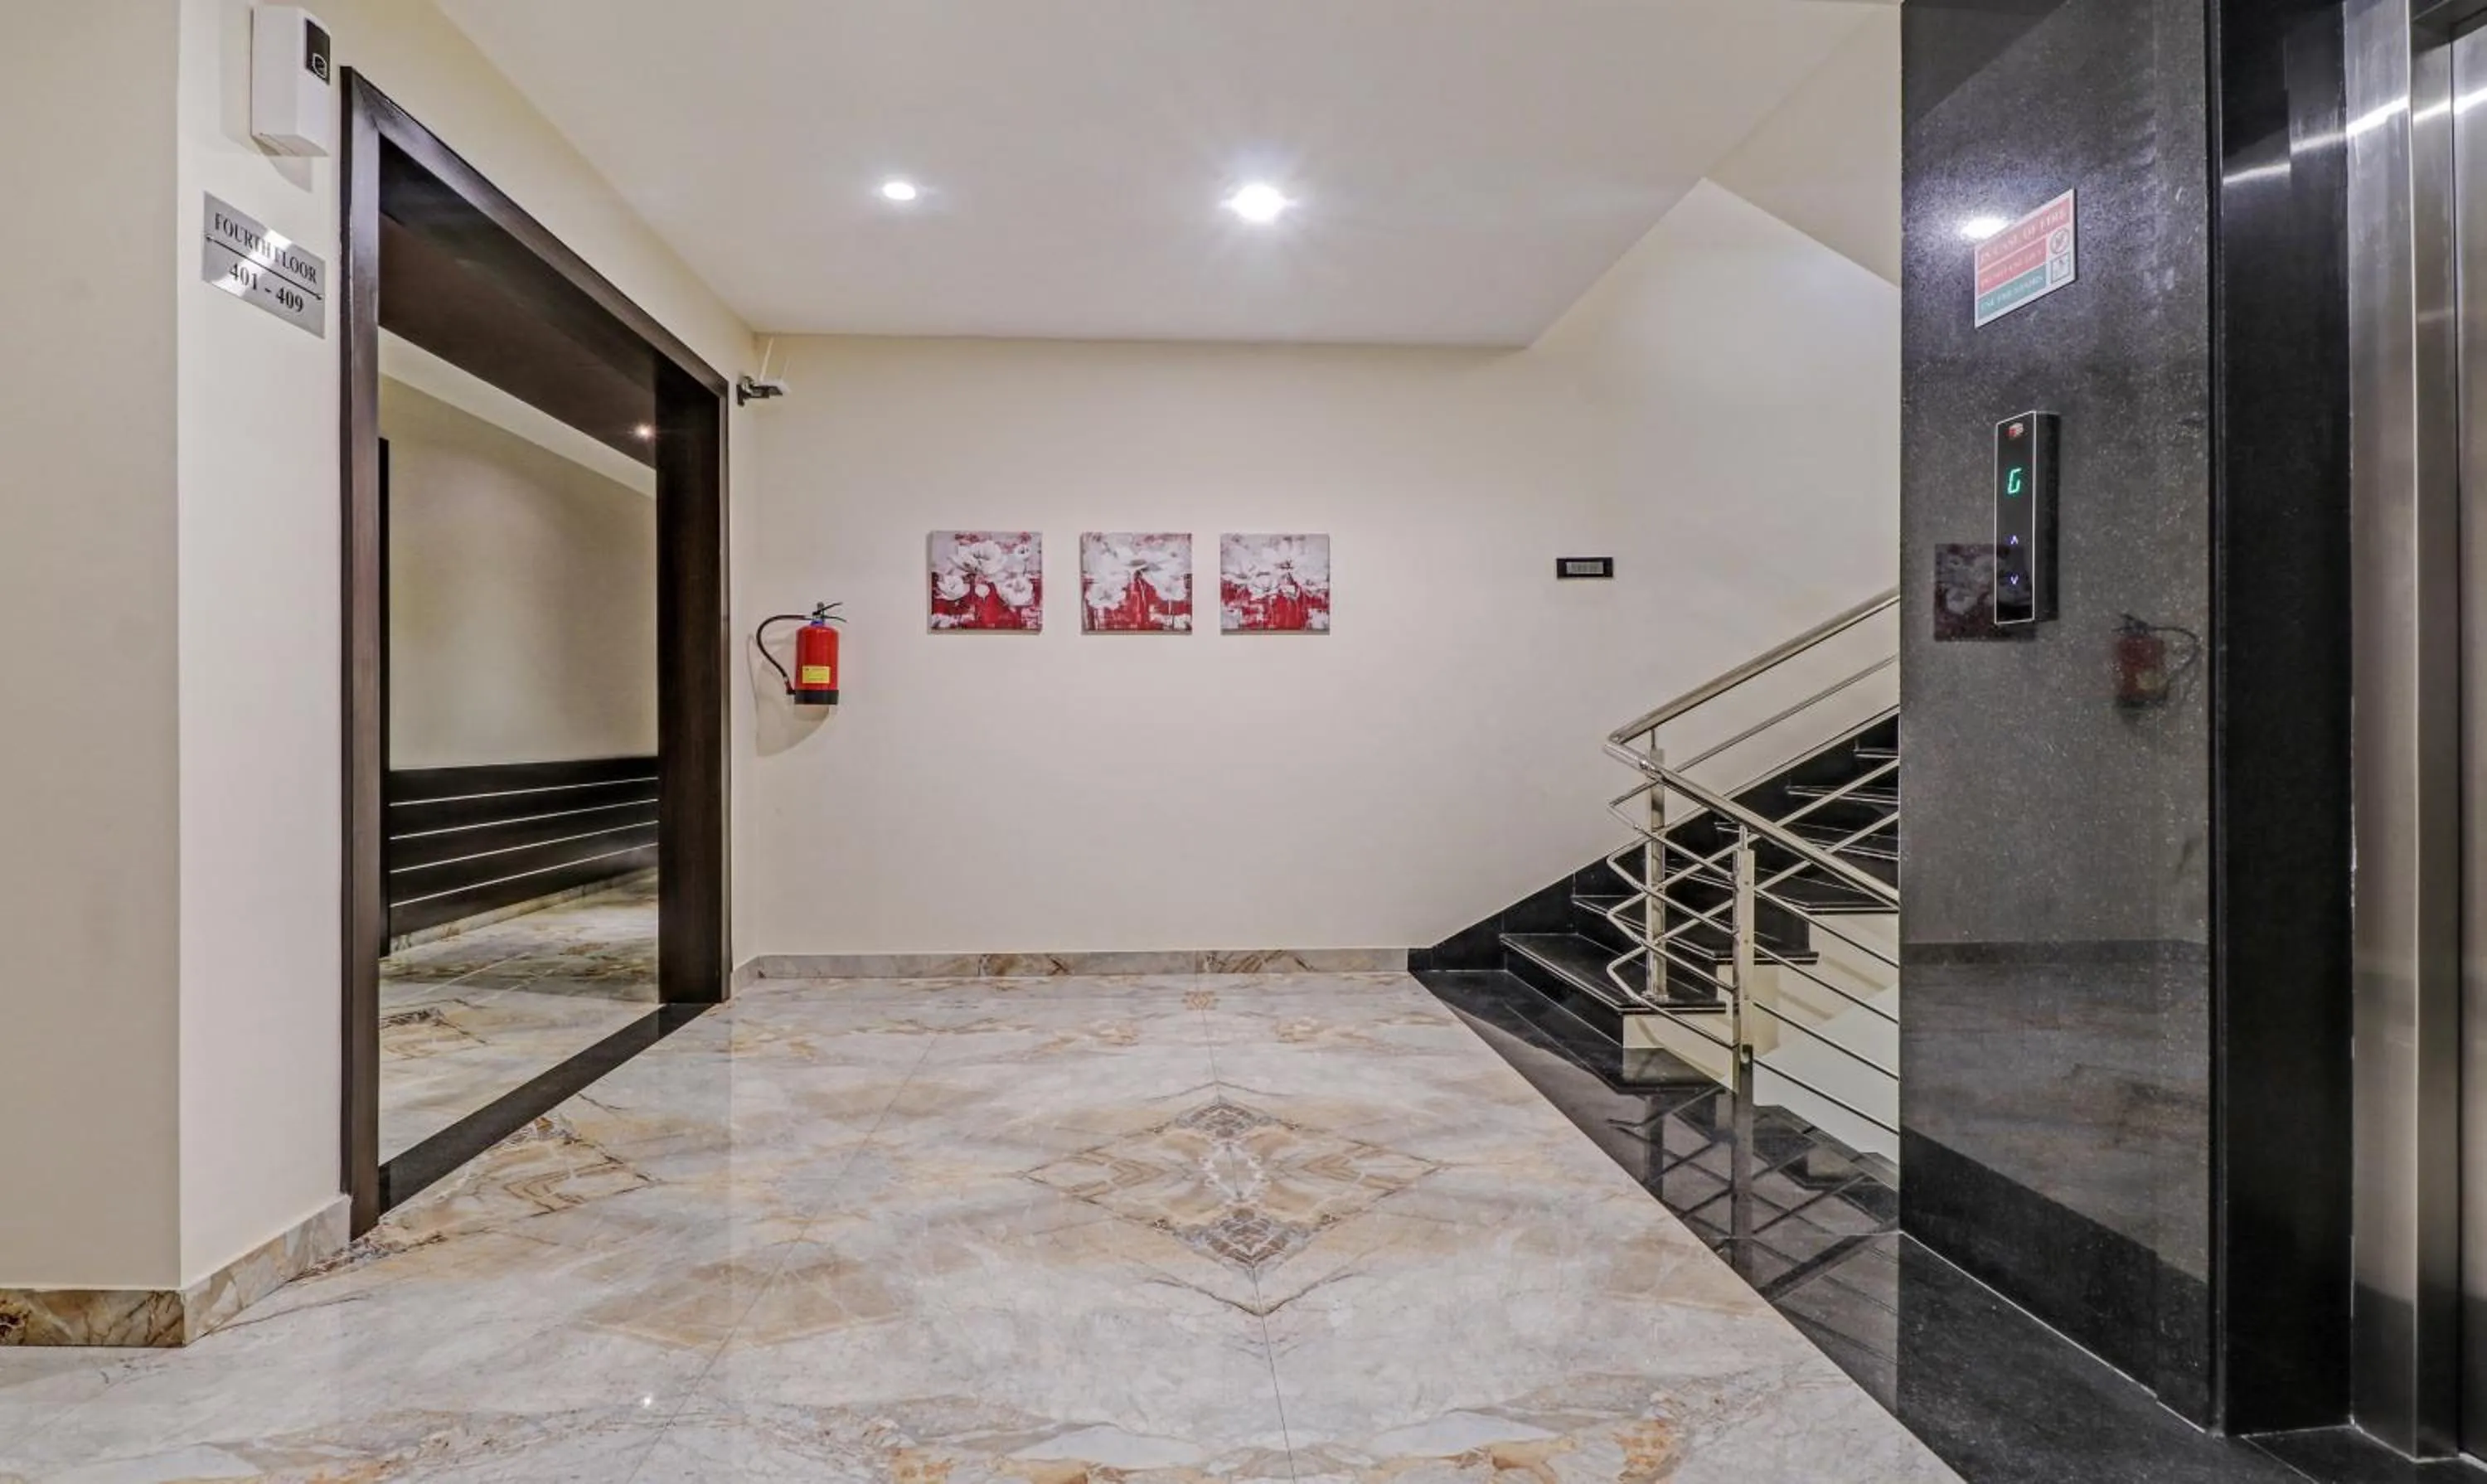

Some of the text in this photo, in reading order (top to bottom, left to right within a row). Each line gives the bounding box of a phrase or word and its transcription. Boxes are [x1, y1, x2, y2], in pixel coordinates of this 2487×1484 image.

[214, 212, 317, 284] FOURTH FLOOR
[229, 262, 257, 290] 401
[276, 288, 304, 313] 409
